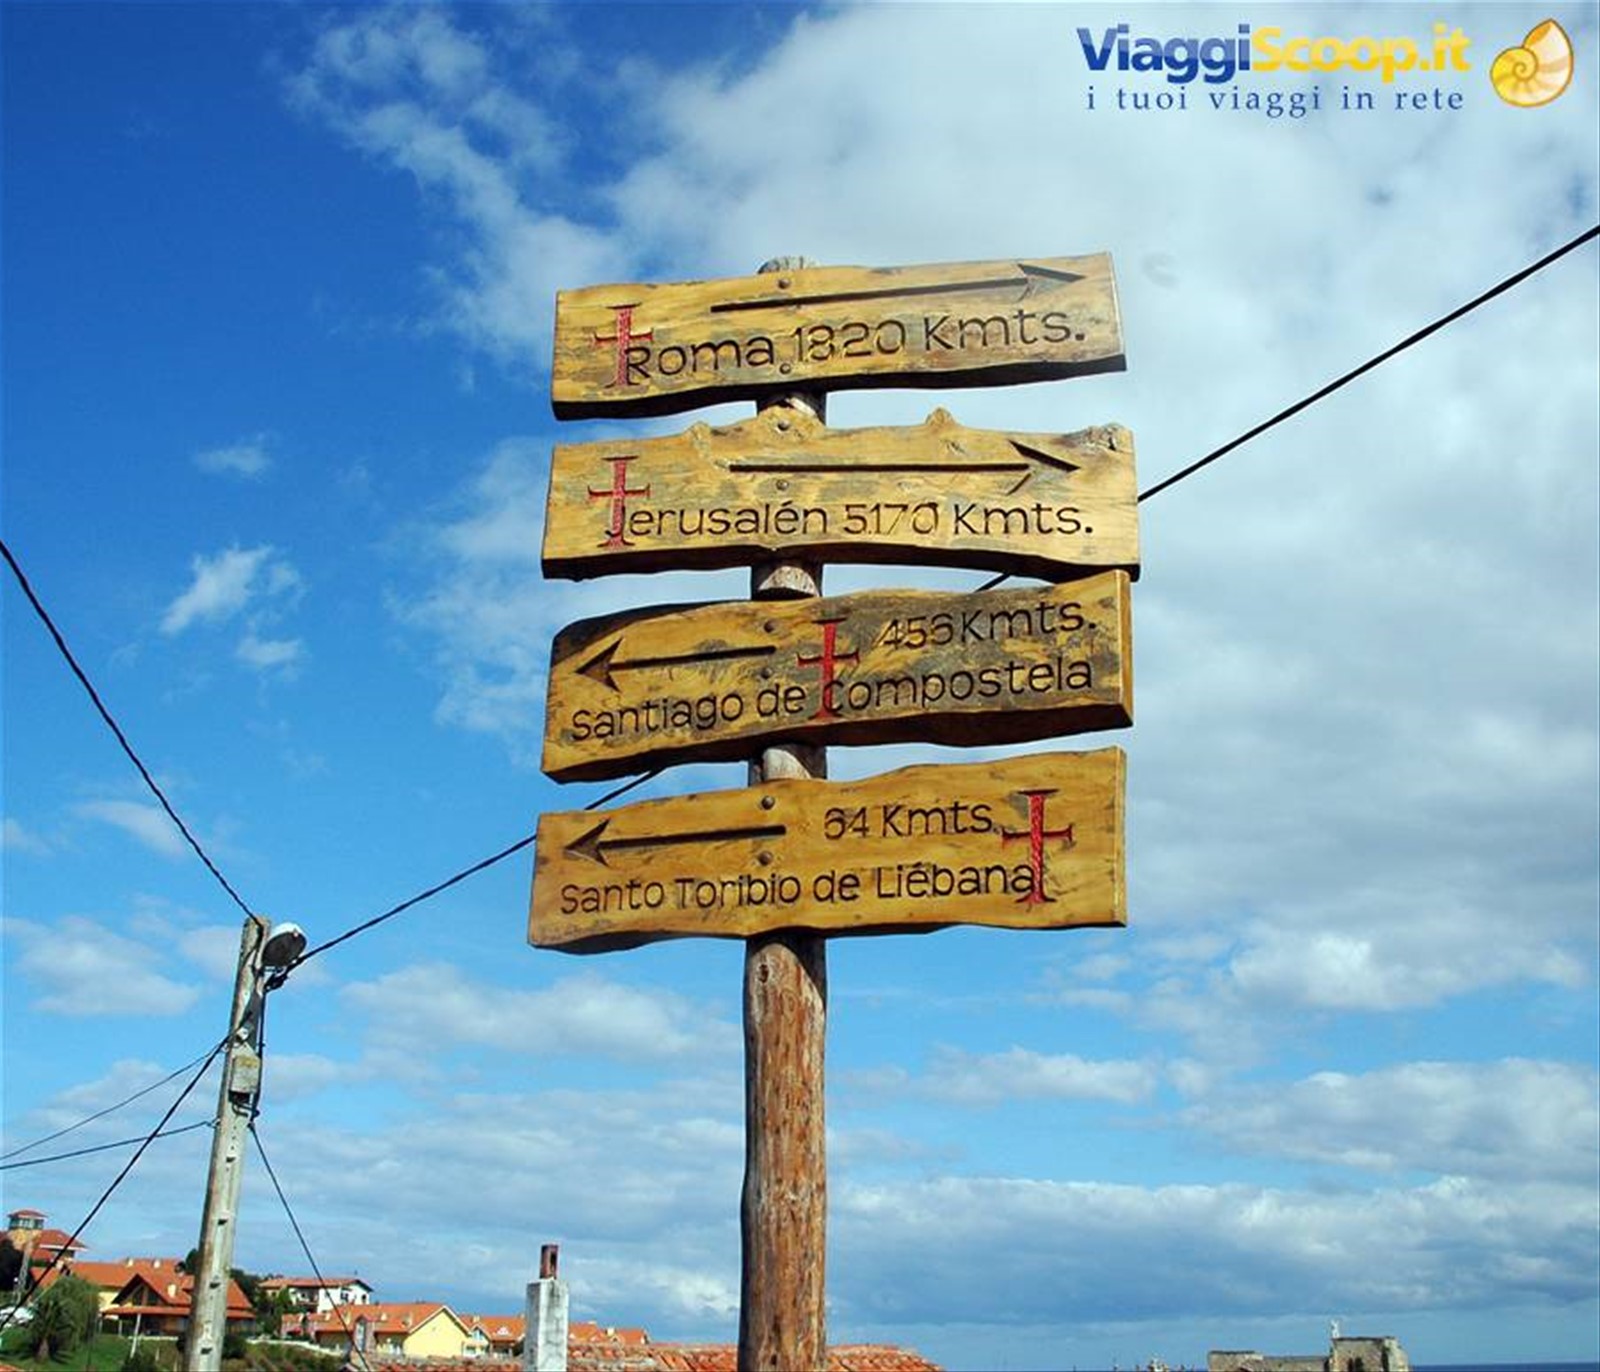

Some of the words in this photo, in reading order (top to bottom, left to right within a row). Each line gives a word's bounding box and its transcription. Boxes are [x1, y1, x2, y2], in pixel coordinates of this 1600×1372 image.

[625, 336, 775, 386] Roma
[924, 309, 1086, 352] Kmts.
[604, 500, 829, 538] Jerusalén
[953, 502, 1093, 536] Kmts.
[571, 693, 744, 741] Santiago
[757, 683, 806, 718] de
[824, 806, 870, 840] 64
[560, 879, 665, 914] Santo
[674, 872, 801, 909] Toribio
[813, 870, 860, 903] de
[876, 862, 1036, 899] Liébana
